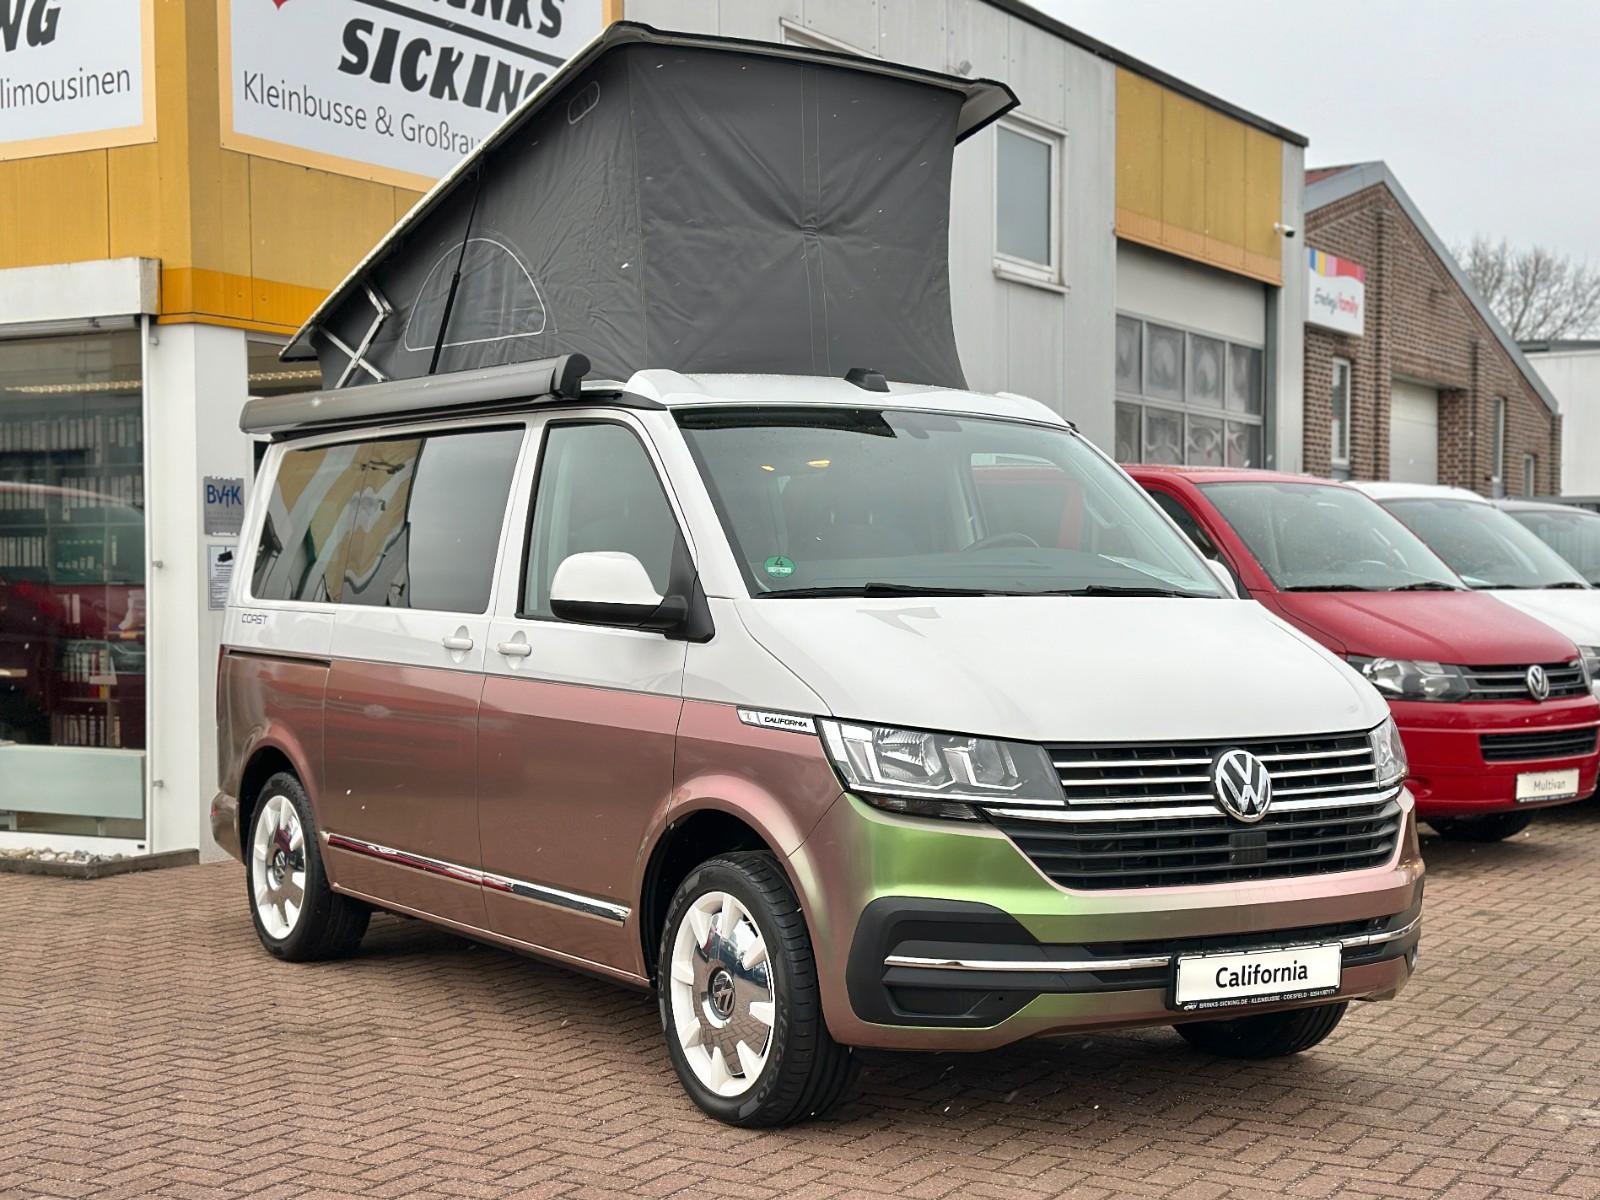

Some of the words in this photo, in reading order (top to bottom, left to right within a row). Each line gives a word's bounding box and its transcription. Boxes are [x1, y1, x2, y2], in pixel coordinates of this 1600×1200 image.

[0, 67, 130, 109] limousinen
[244, 70, 367, 130] Kleinbusse
[375, 106, 394, 137] &
[207, 484, 242, 508] BVfK
[774, 556, 784, 567] 4
[241, 613, 267, 625] COAST
[764, 716, 808, 728] CALIFORNIA
[1533, 778, 1566, 792] Multivan
[1215, 960, 1308, 988] California
